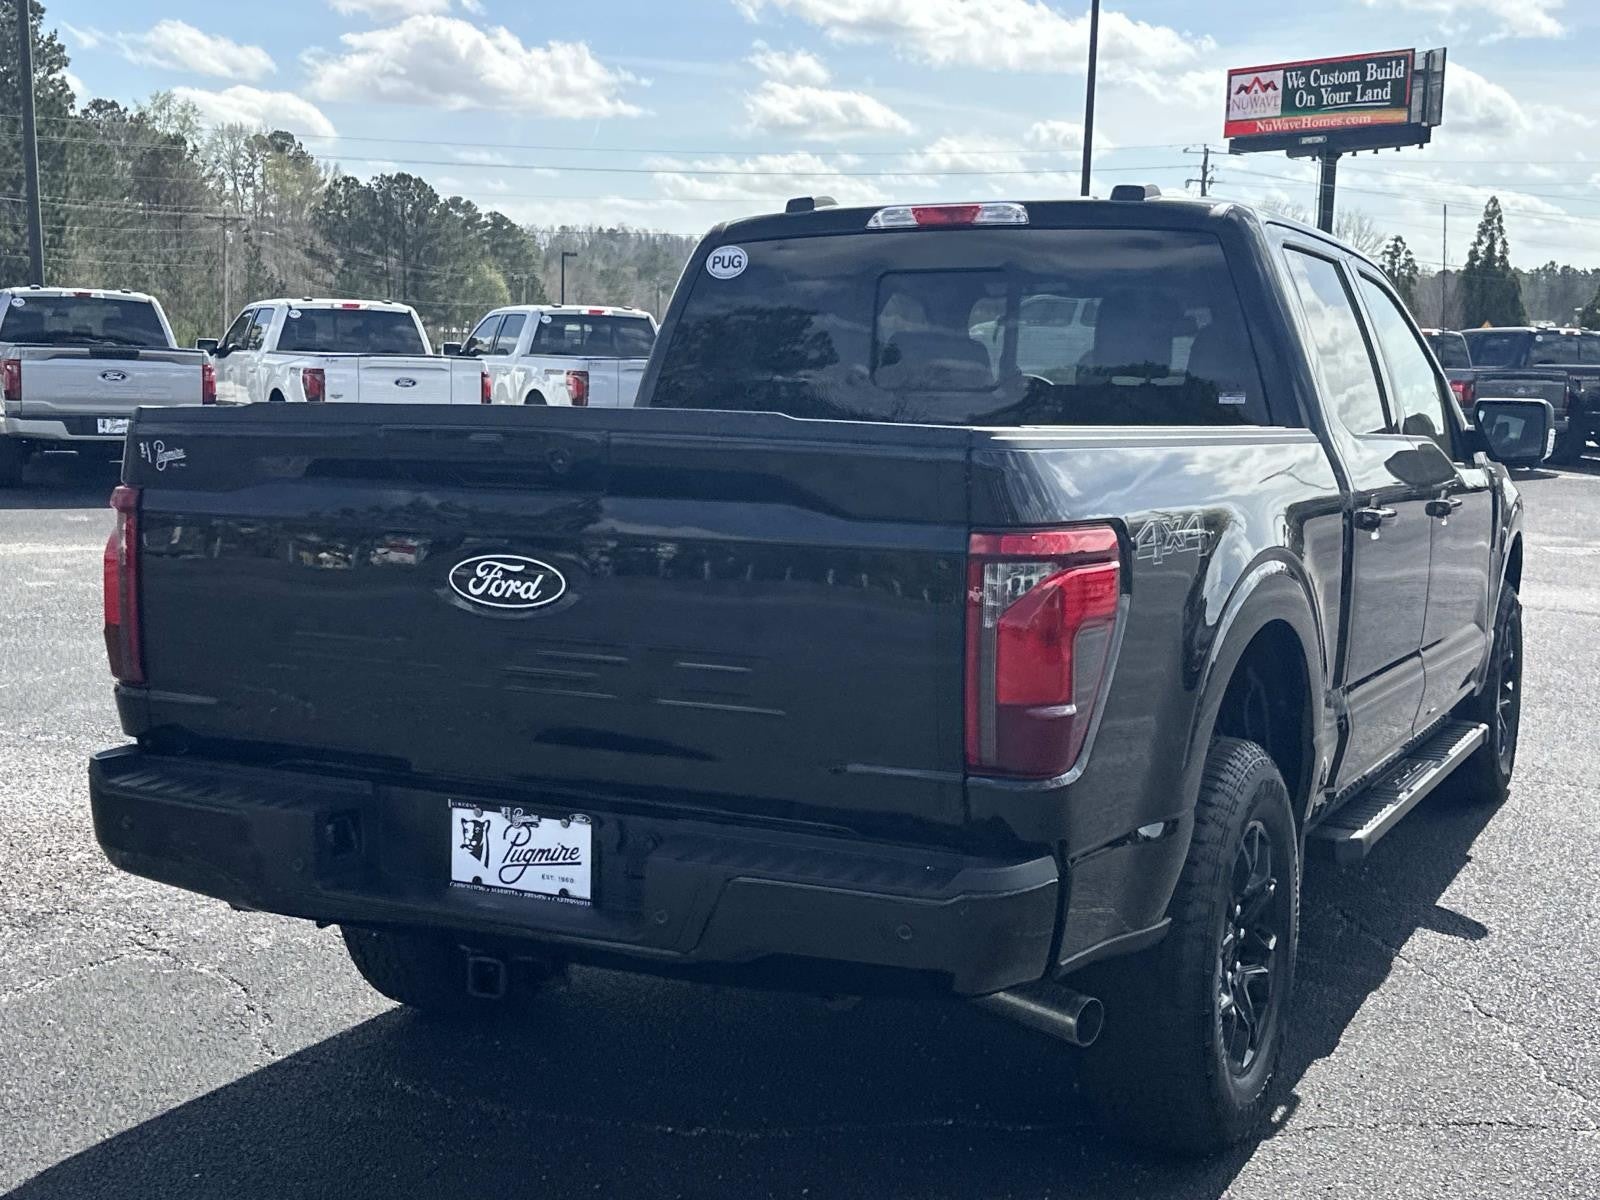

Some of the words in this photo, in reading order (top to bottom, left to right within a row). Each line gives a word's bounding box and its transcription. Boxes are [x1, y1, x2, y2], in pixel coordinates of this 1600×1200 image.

[1286, 71, 1306, 89] We
[1310, 69, 1360, 88] Custom
[1366, 60, 1404, 81] Build
[1295, 90, 1316, 108] On
[1320, 87, 1351, 105] Your
[1356, 81, 1391, 102] Land
[1256, 115, 1371, 133] NuWaveHomes.com
[712, 255, 742, 269] PUG
[468, 561, 543, 600] Ford
[499, 824, 582, 884] Pugmire
